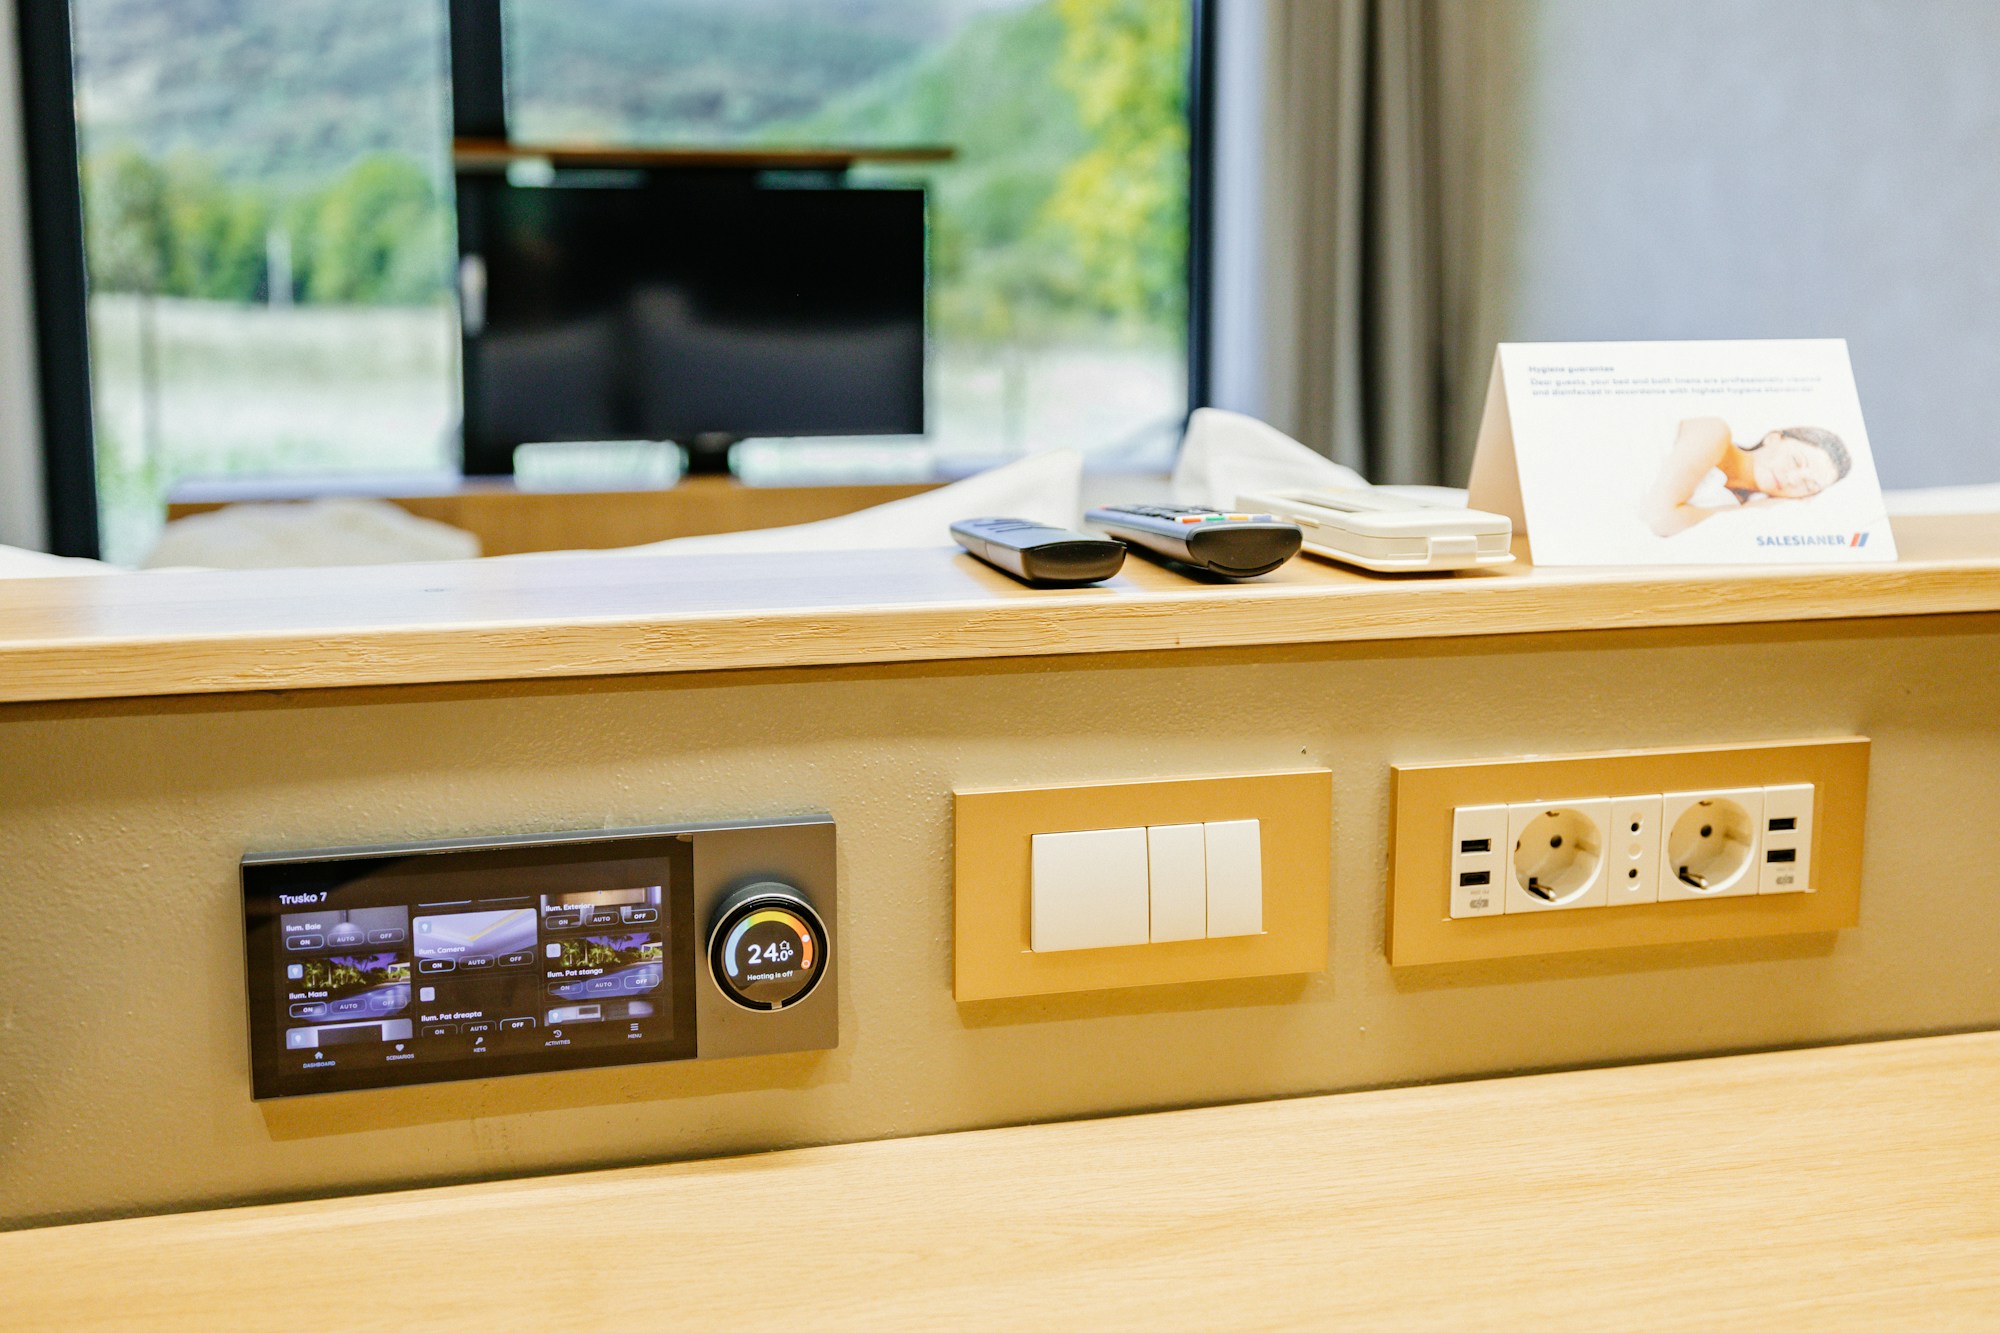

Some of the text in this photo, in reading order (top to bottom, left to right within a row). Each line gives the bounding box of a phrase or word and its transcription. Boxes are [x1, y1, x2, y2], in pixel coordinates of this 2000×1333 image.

[1756, 534, 1846, 546] SALESIANER
[280, 892, 327, 904] Trusko 7
[633, 912, 646, 920] OFF
[336, 935, 355, 943] AUTO
[437, 946, 465, 954] Camera
[565, 969, 577, 977] Pat
[578, 967, 603, 976] stanga
[747, 972, 775, 981] Heating
[439, 1012, 452, 1020] Pat
[453, 1010, 483, 1020] dreapta
[545, 1039, 571, 1047] ACTIVITIES
[386, 1053, 414, 1061] SCENARIOS
[303, 1060, 336, 1069] DASHBOARD
